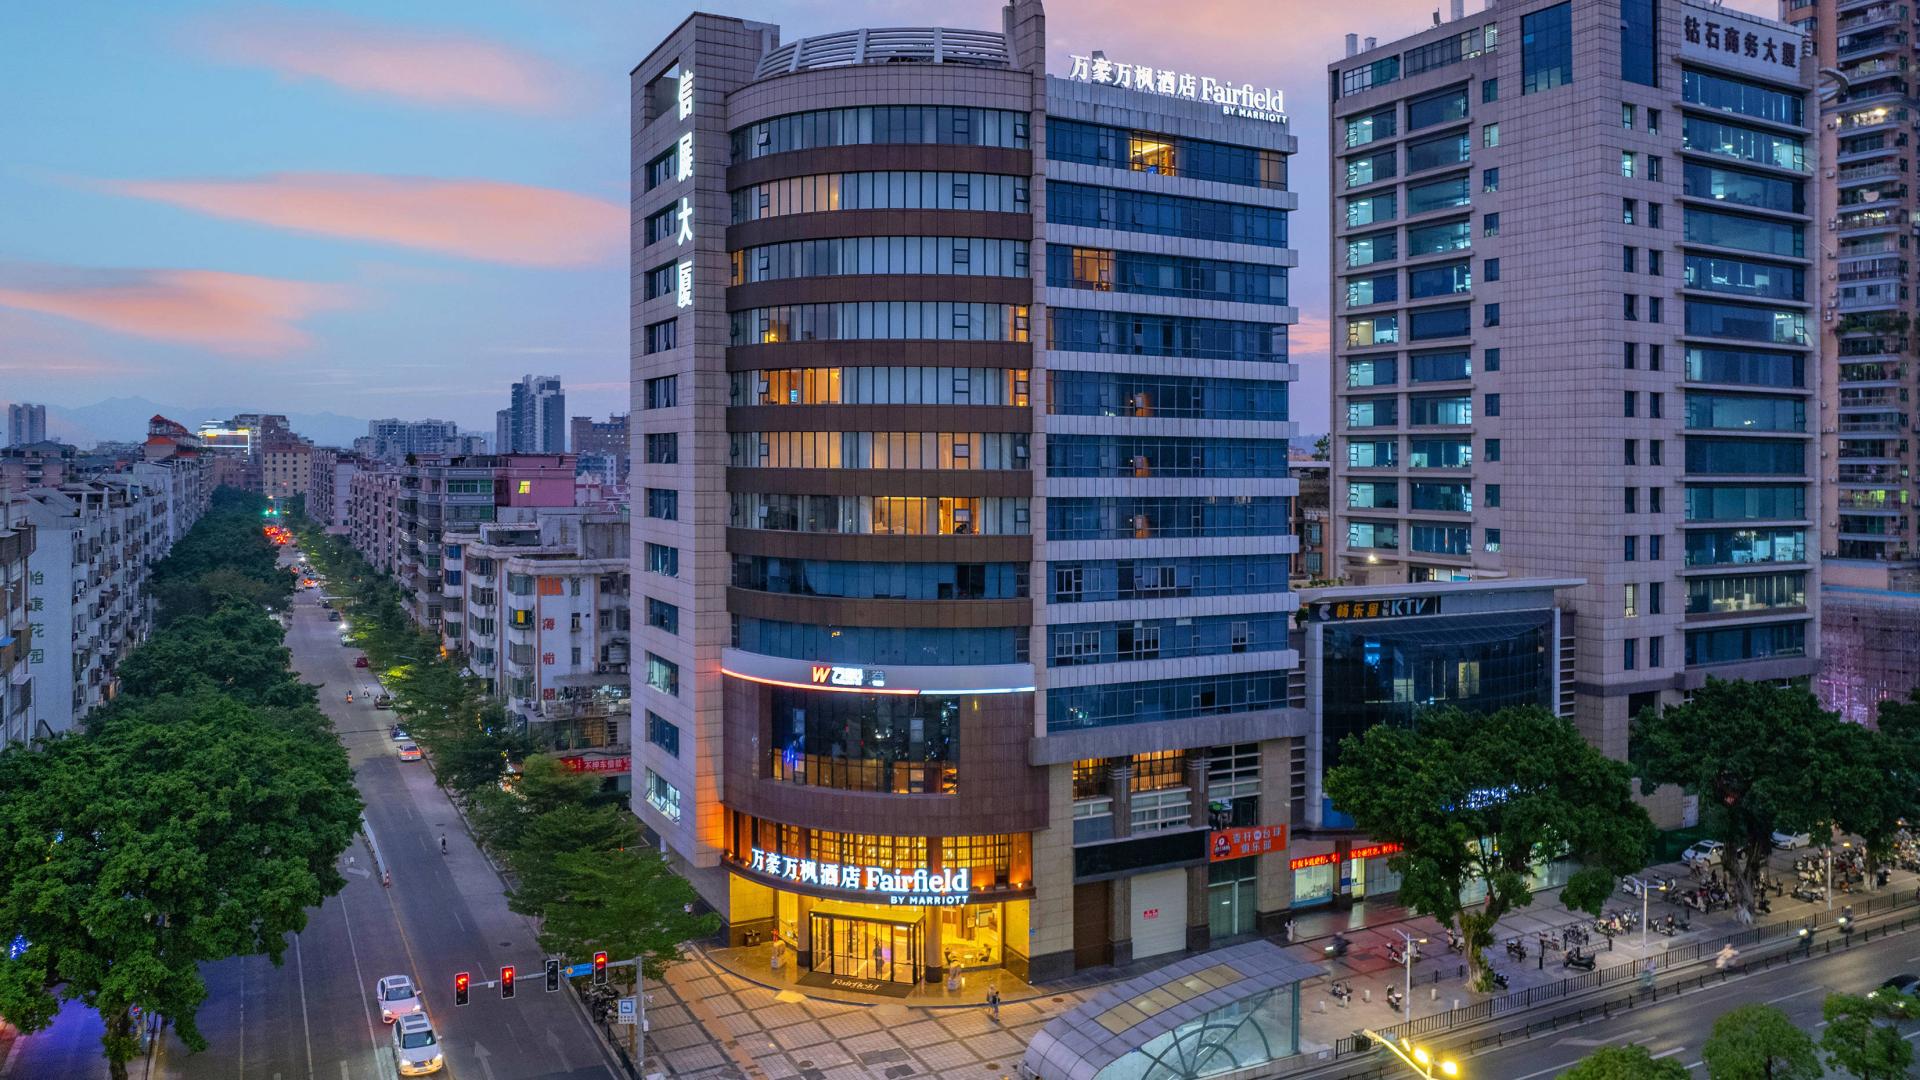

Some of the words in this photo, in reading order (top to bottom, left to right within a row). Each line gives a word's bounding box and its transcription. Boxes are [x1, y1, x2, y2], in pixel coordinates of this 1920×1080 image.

[1684, 15, 1797, 68] 钻石商务大厦
[1069, 54, 1197, 98] 万豪万枫酒店
[1200, 77, 1285, 113] Fairfield
[1223, 105, 1235, 116] BY
[1239, 108, 1288, 124] MARRIOTT
[677, 69, 694, 309] 信展大厦
[1391, 598, 1428, 616] KTV
[751, 848, 860, 890] 万豪万枫酒店
[865, 866, 969, 893] Fairfield
[890, 896, 906, 905] BY
[909, 895, 969, 905] MARRIOTT
[831, 978, 880, 991] Fairfield
